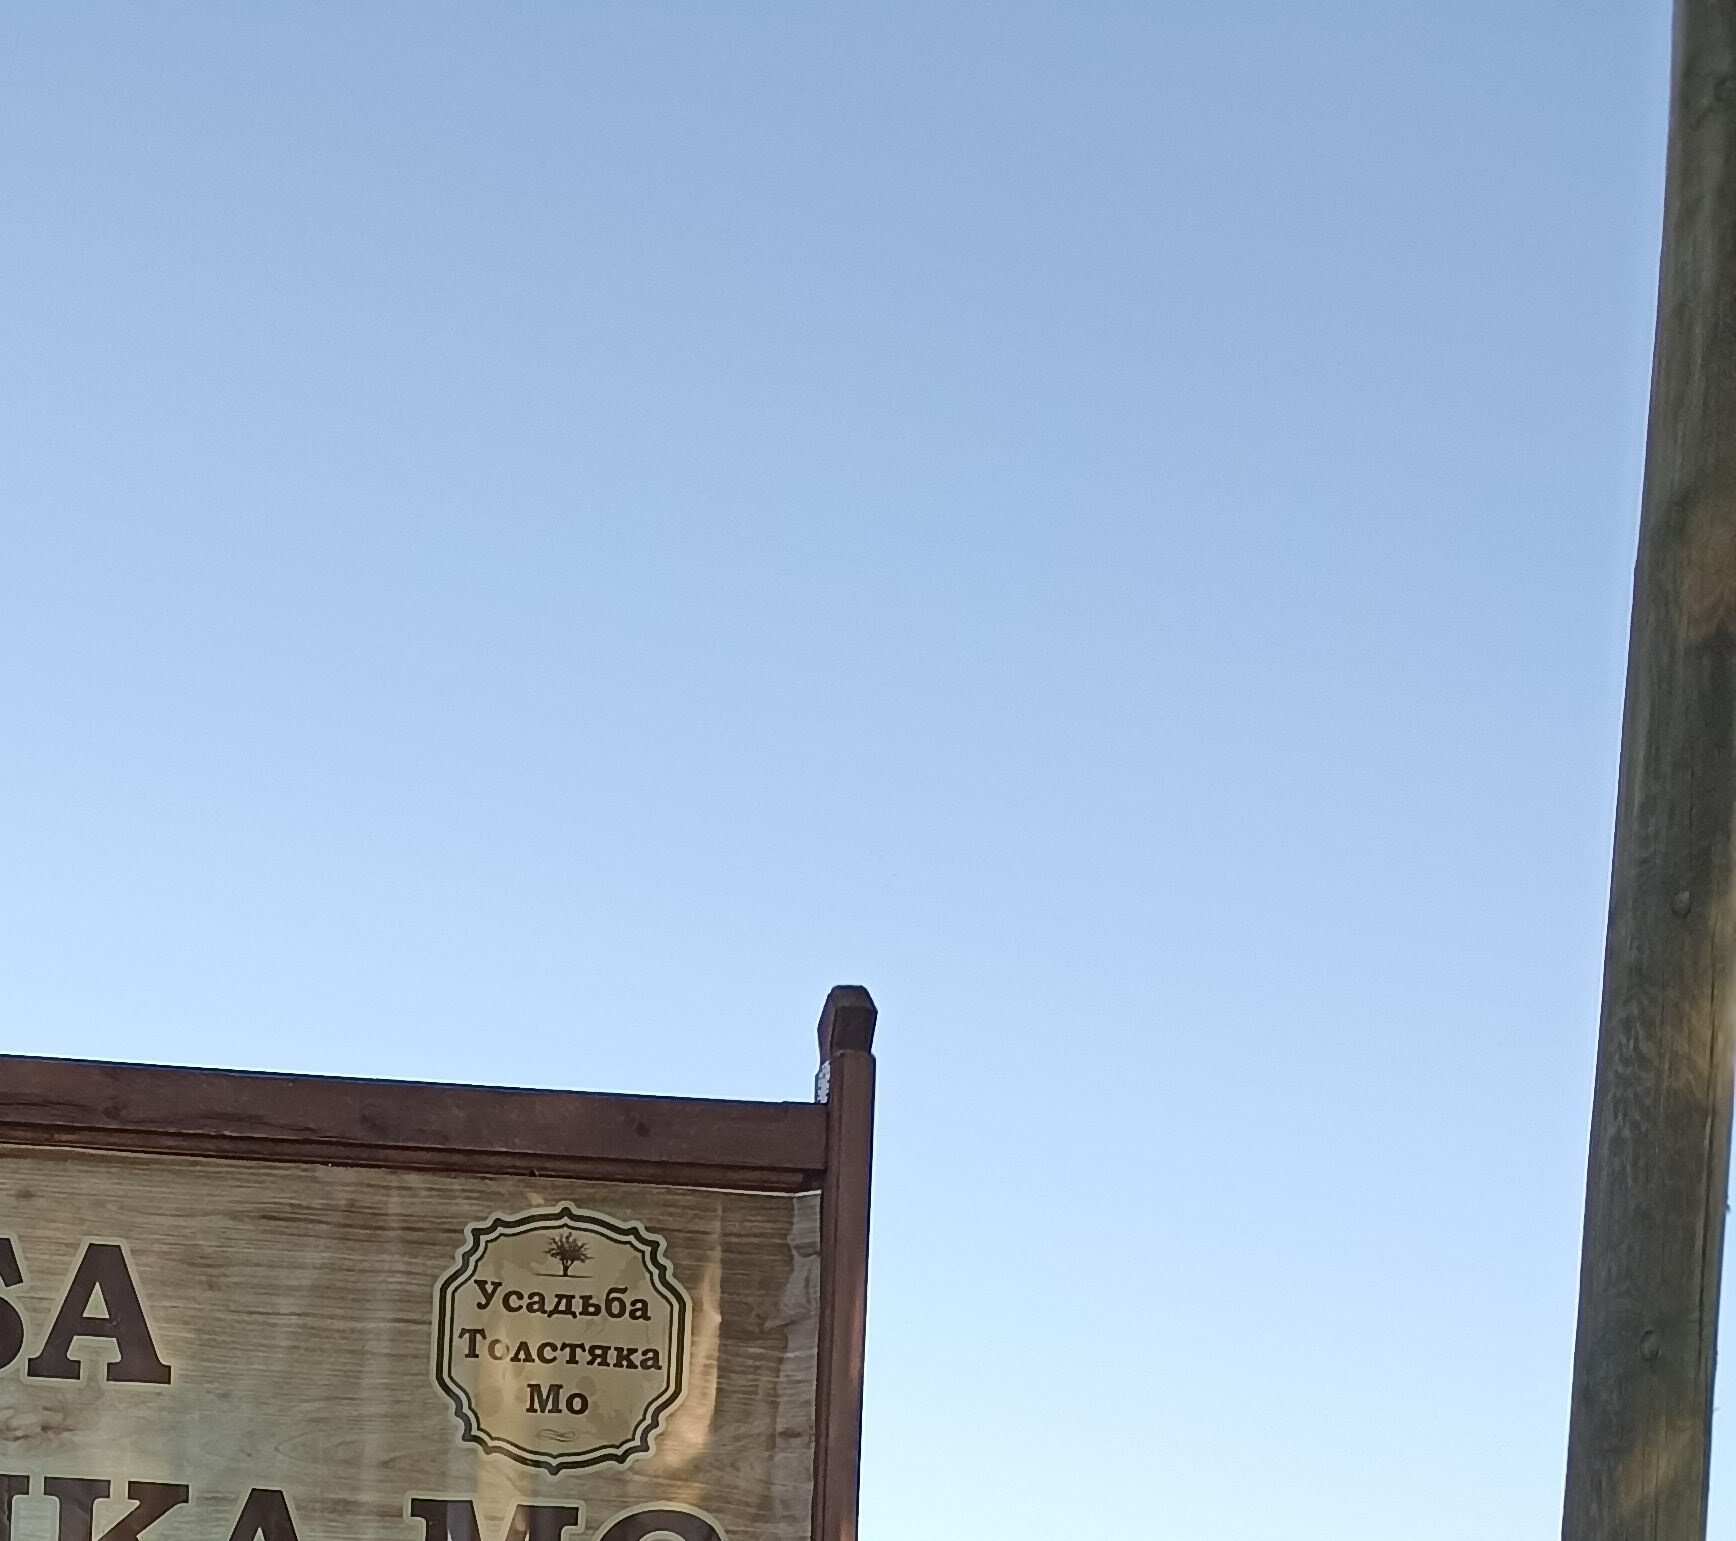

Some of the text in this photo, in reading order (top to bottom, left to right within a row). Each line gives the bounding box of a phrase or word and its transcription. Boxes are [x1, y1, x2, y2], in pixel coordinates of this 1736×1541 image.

[473, 1279, 652, 1322] Усадьба
[458, 1327, 663, 1371] Толстяка
[525, 1382, 590, 1416] Мо
